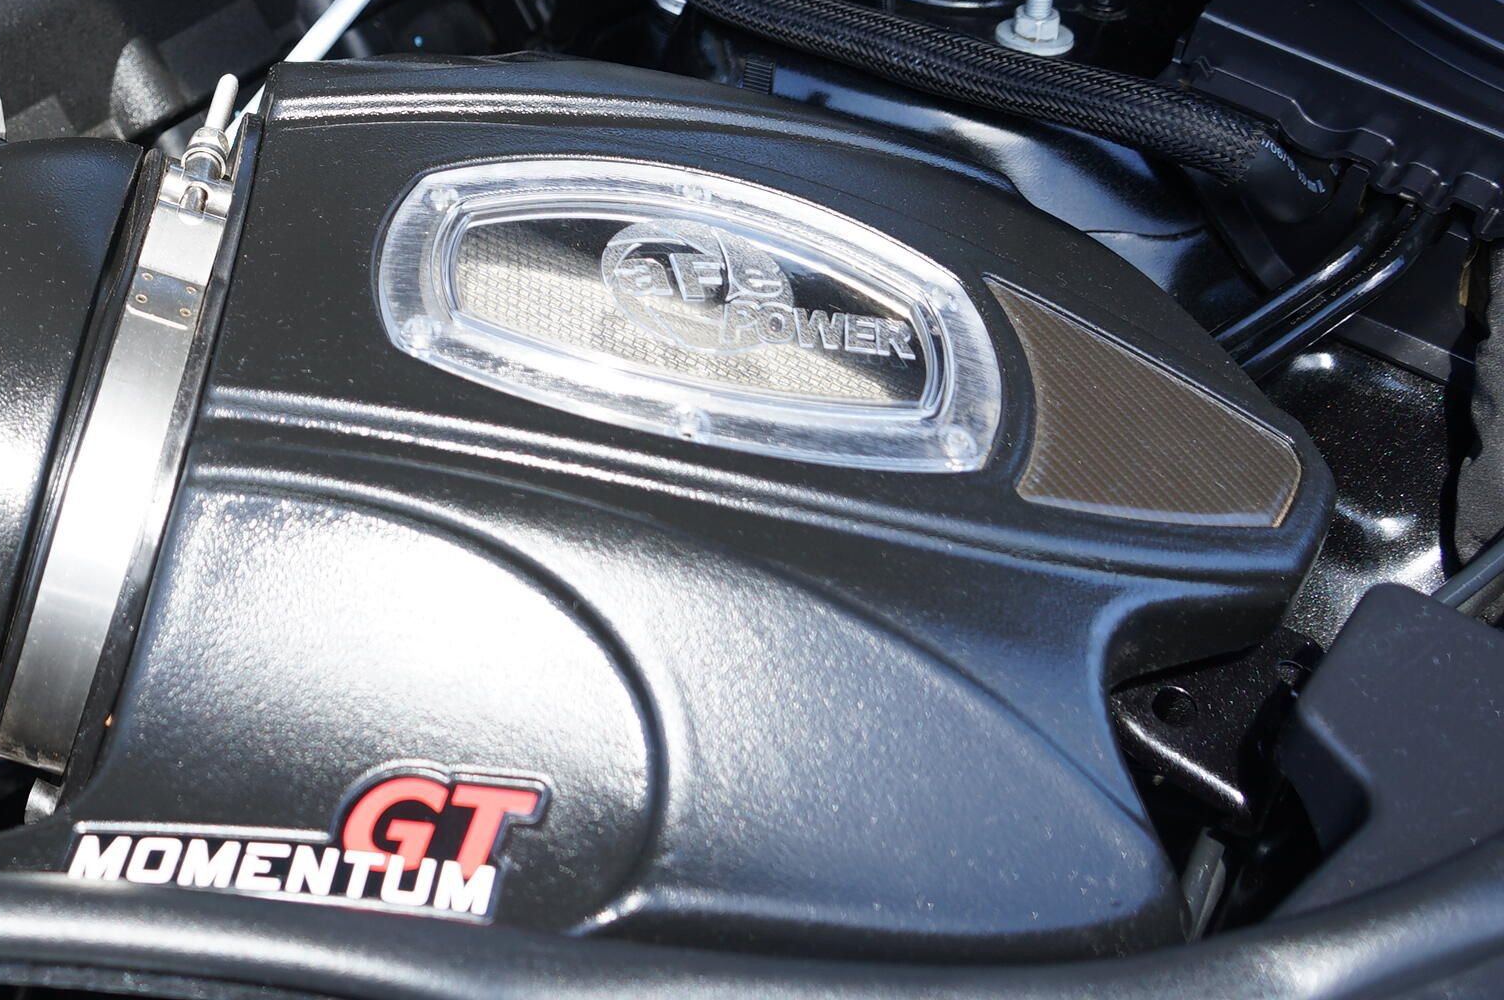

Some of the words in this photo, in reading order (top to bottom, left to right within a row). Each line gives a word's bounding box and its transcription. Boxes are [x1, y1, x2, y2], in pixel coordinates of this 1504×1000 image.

[719, 301, 917, 362] POWER
[341, 776, 539, 880] GT
[67, 834, 497, 917] MOMENTUM
